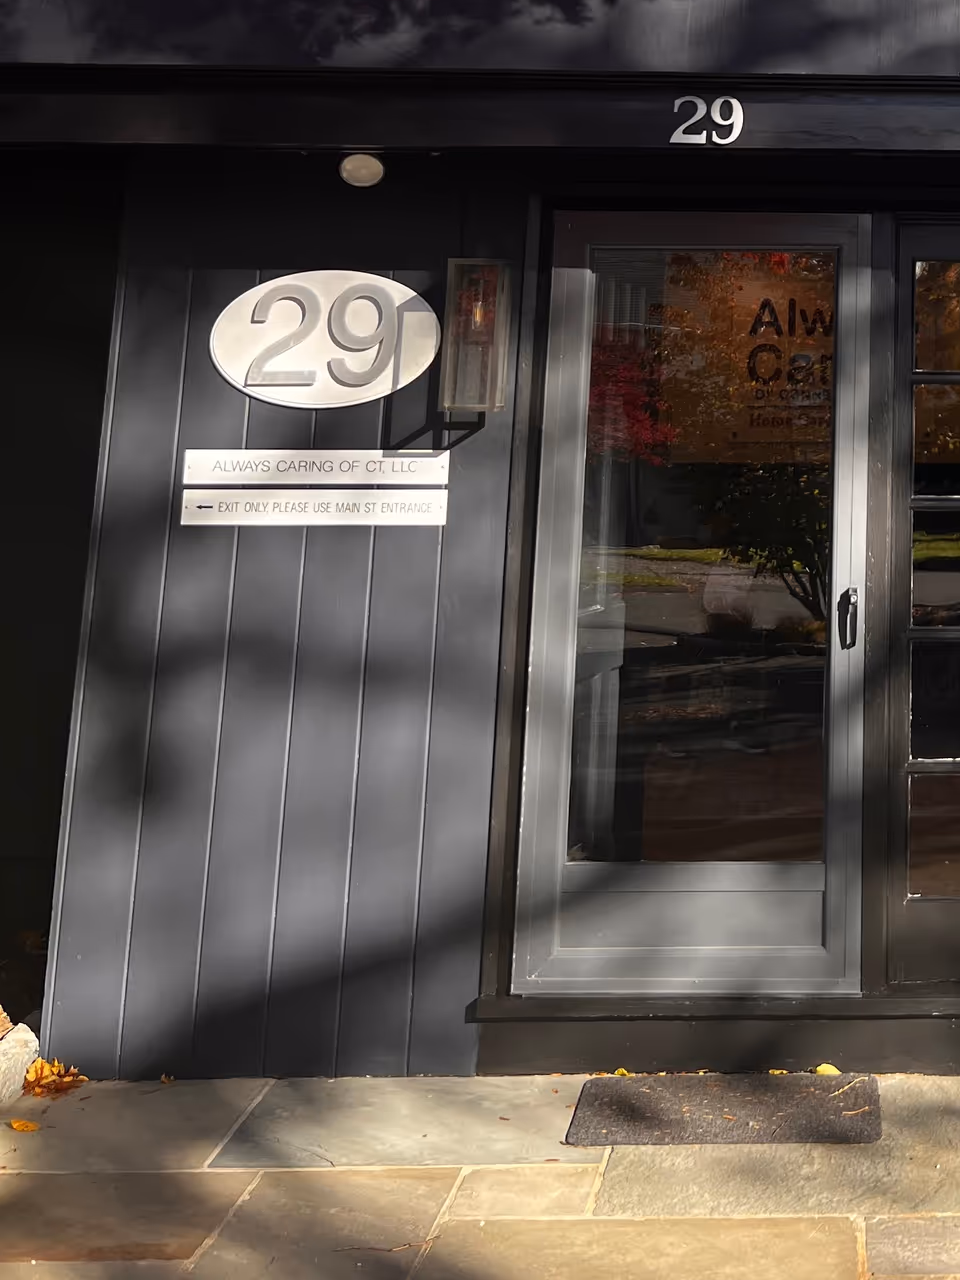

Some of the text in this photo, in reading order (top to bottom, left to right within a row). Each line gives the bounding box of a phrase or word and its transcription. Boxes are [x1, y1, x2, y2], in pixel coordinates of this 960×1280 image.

[669, 95, 744, 145] 29
[244, 283, 398, 388] 29
[212, 460, 418, 475] ALWAYS CARING OF CT, LLC
[218, 501, 240, 513] EXIT
[272, 501, 309, 513] PLEASE
[313, 501, 332, 513] USE
[335, 501, 361, 513] MAIN
[364, 501, 376, 513] ST
[381, 501, 432, 513] ENTRANCE
